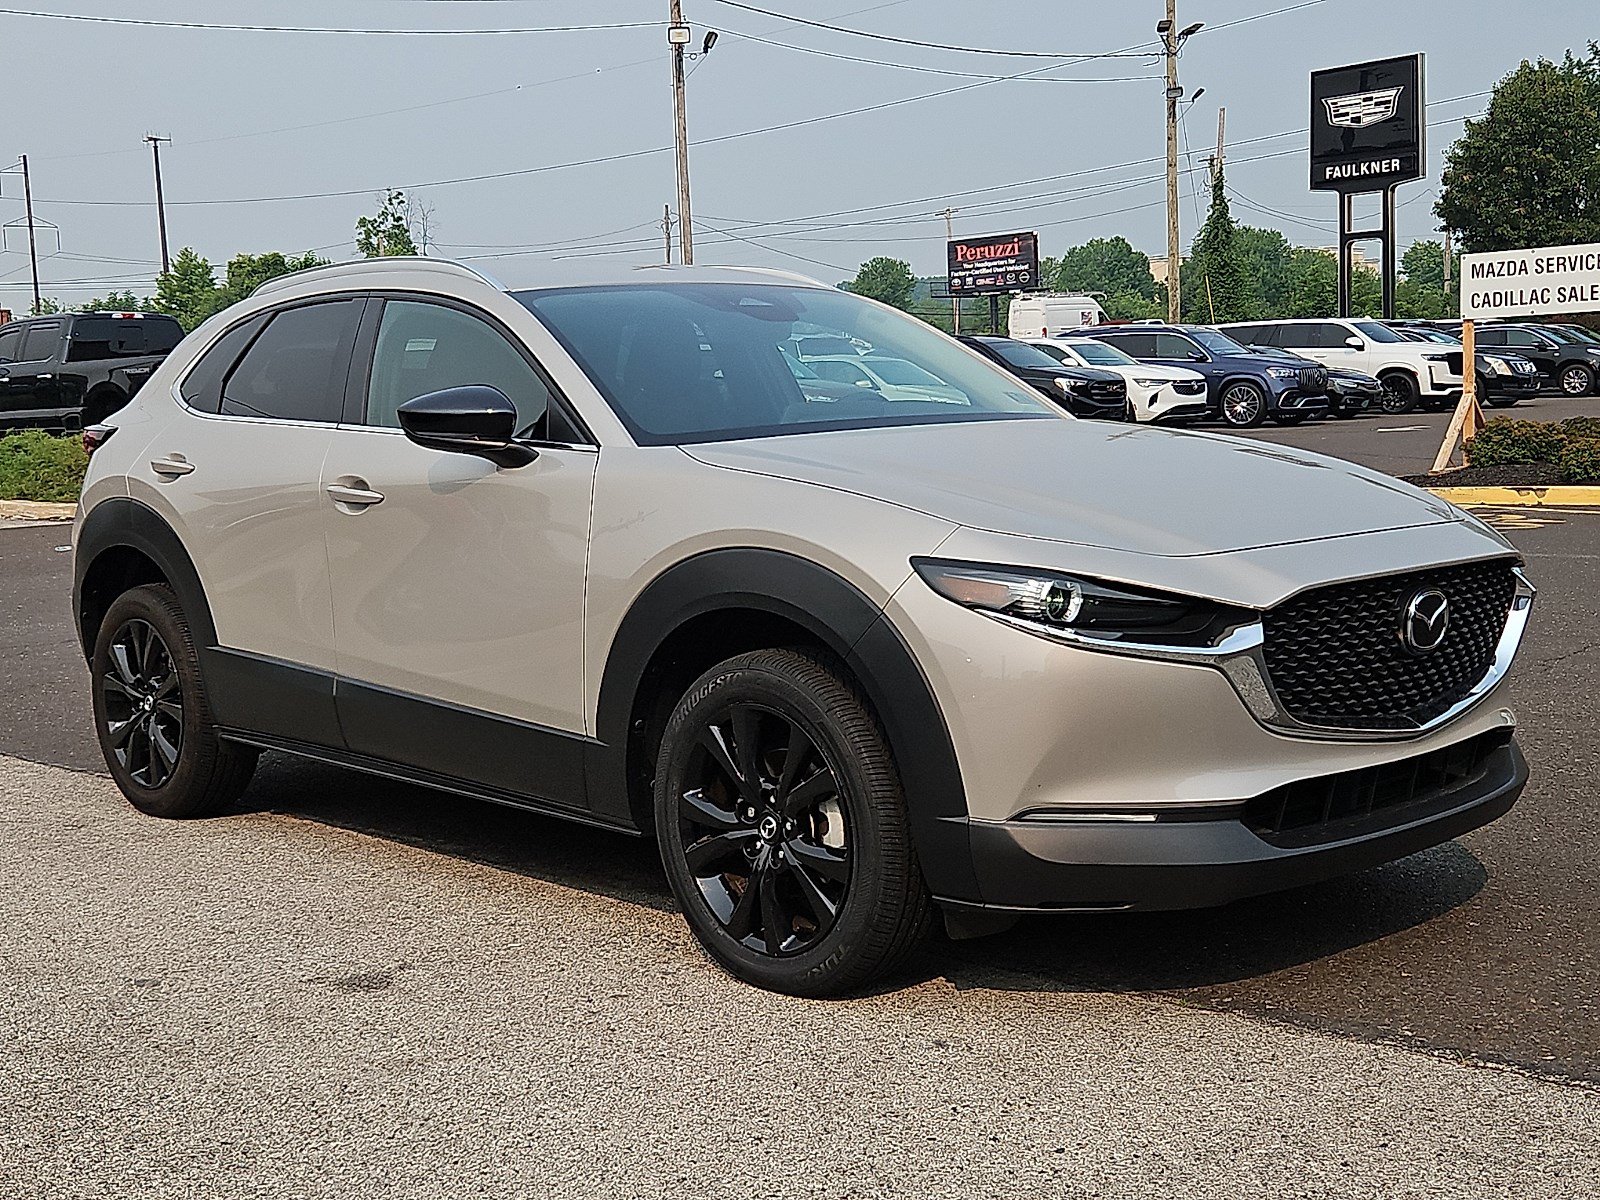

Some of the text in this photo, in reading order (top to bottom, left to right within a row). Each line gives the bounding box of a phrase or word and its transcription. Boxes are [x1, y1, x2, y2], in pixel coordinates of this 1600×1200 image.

[1325, 158, 1401, 180] FAULKNER
[955, 237, 1020, 262] Peruzzi
[1471, 259, 1529, 279] MAZDA
[976, 278, 995, 286] GMC
[1471, 287, 1551, 309] CADILLAC
